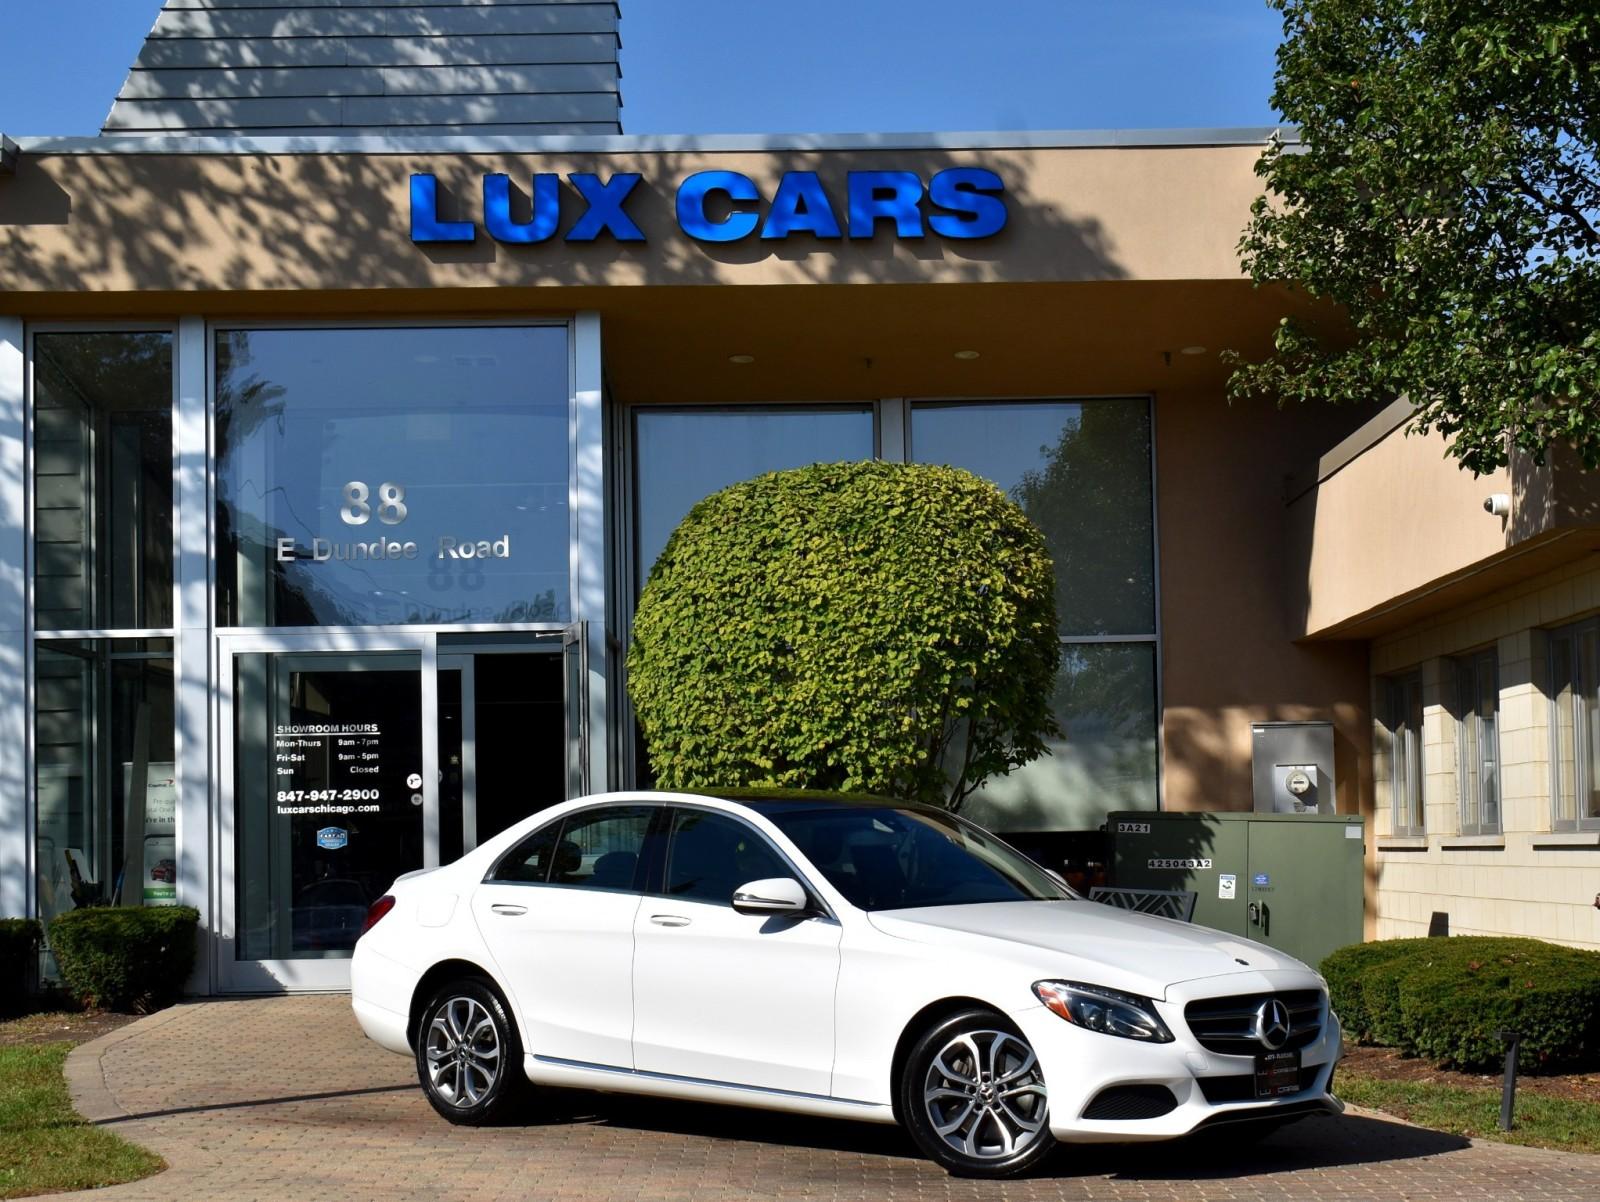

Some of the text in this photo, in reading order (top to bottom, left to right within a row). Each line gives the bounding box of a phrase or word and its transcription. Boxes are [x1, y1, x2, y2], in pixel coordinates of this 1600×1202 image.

[410, 167, 1008, 243] LUX CARS
[340, 481, 408, 525] 88
[276, 534, 510, 562] E Dundee Road
[277, 723, 379, 734] SHOWROOM HOURS
[276, 739, 321, 748] Mon-Thurs
[338, 738, 356, 746] 9am
[361, 738, 379, 747] 7pm
[276, 753, 306, 762] Fri-Sat
[338, 753, 356, 761] 9am
[361, 752, 379, 761] 5pm
[277, 765, 379, 775] Sun Closed
[277, 789, 380, 802] 847-947-2900
[277, 804, 380, 815] luxcarschicago.com
[1119, 824, 1149, 832] 3A21
[1148, 859, 1211, 868] 425043A2
